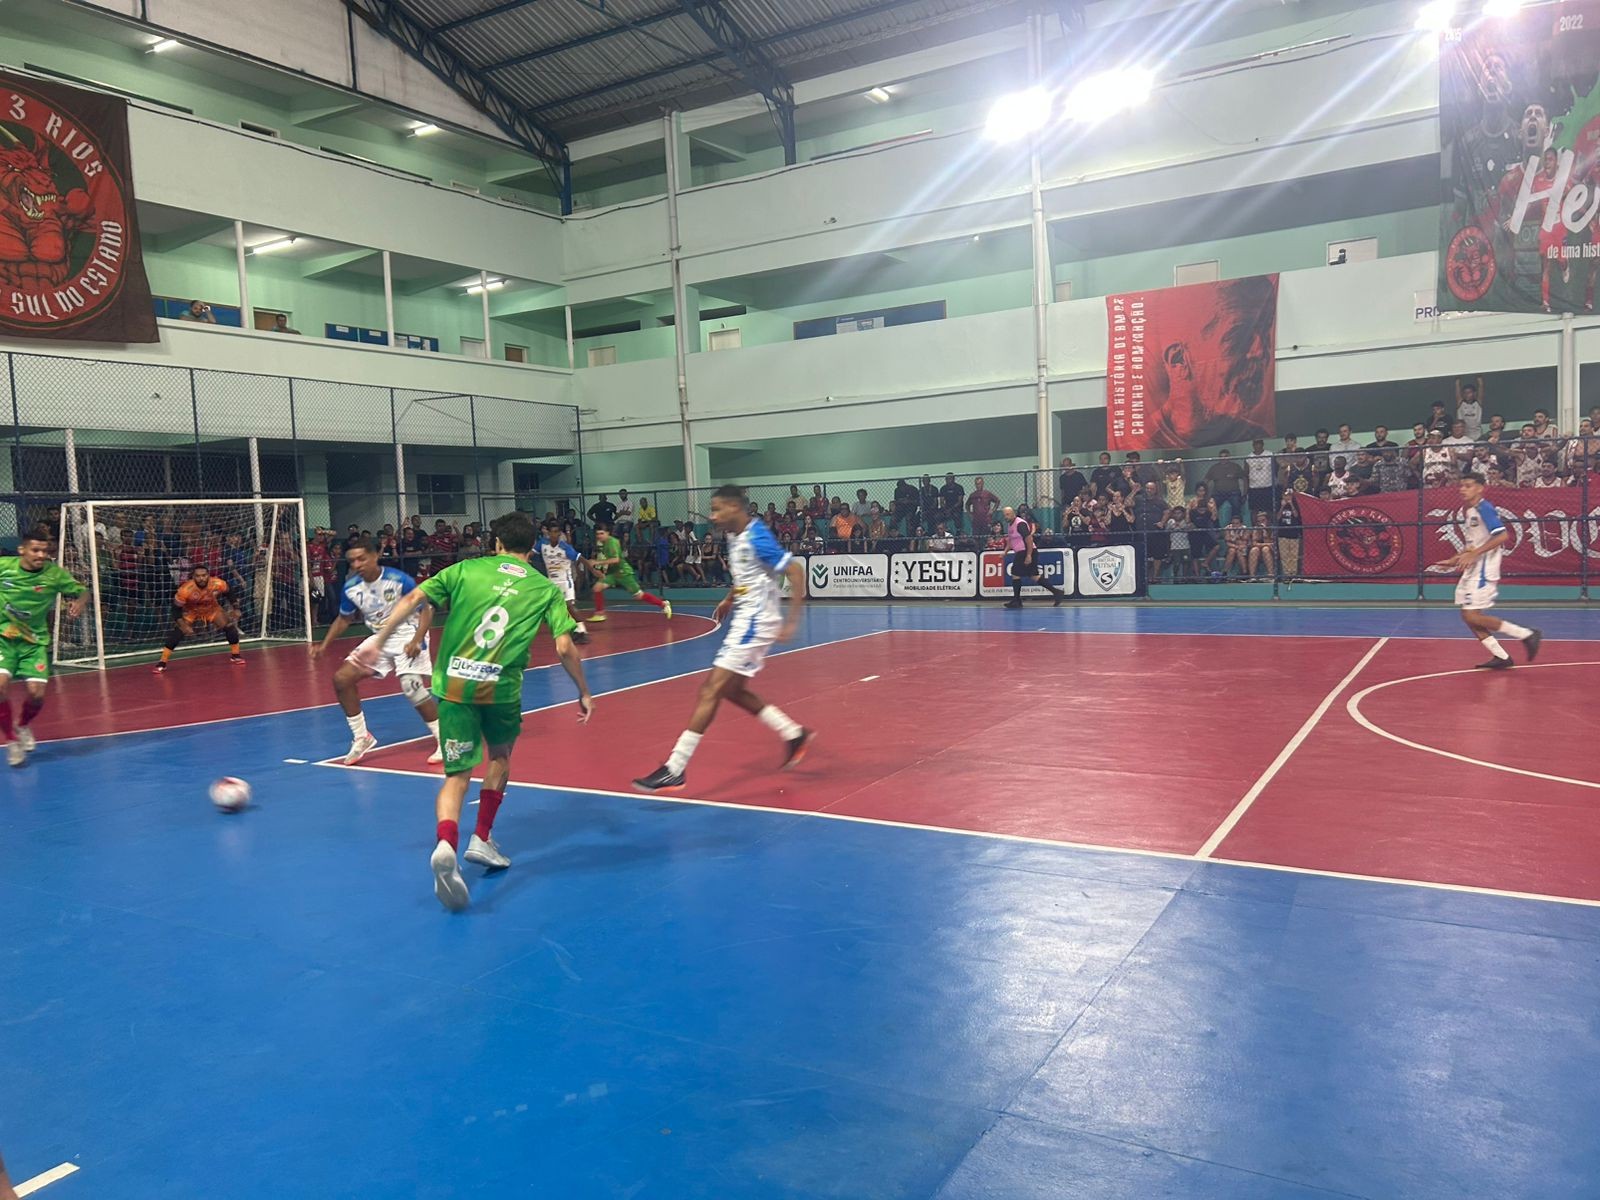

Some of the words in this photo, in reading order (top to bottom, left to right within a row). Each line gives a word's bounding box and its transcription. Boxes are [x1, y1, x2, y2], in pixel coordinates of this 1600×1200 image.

[1560, 15, 1583, 31] 2022
[9, 94, 26, 120] 3
[45, 112, 103, 177] RIOS
[1547, 244, 1559, 259] de
[1561, 245, 1580, 258] uma
[11, 292, 58, 319] SUL
[53, 286, 85, 313] DO
[80, 220, 123, 295] ESTADO
[1114, 336, 1126, 348] DE
[1110, 353, 1126, 405] HISTÓRIA
[1132, 384, 1144, 435] CARINHO
[1113, 411, 1125, 437] UMA
[833, 566, 873, 576] UNIFAA
[902, 560, 963, 582] YESU
[985, 563, 1002, 577] Di
[356, 592, 363, 605] 7
[474, 605, 509, 649] 8
